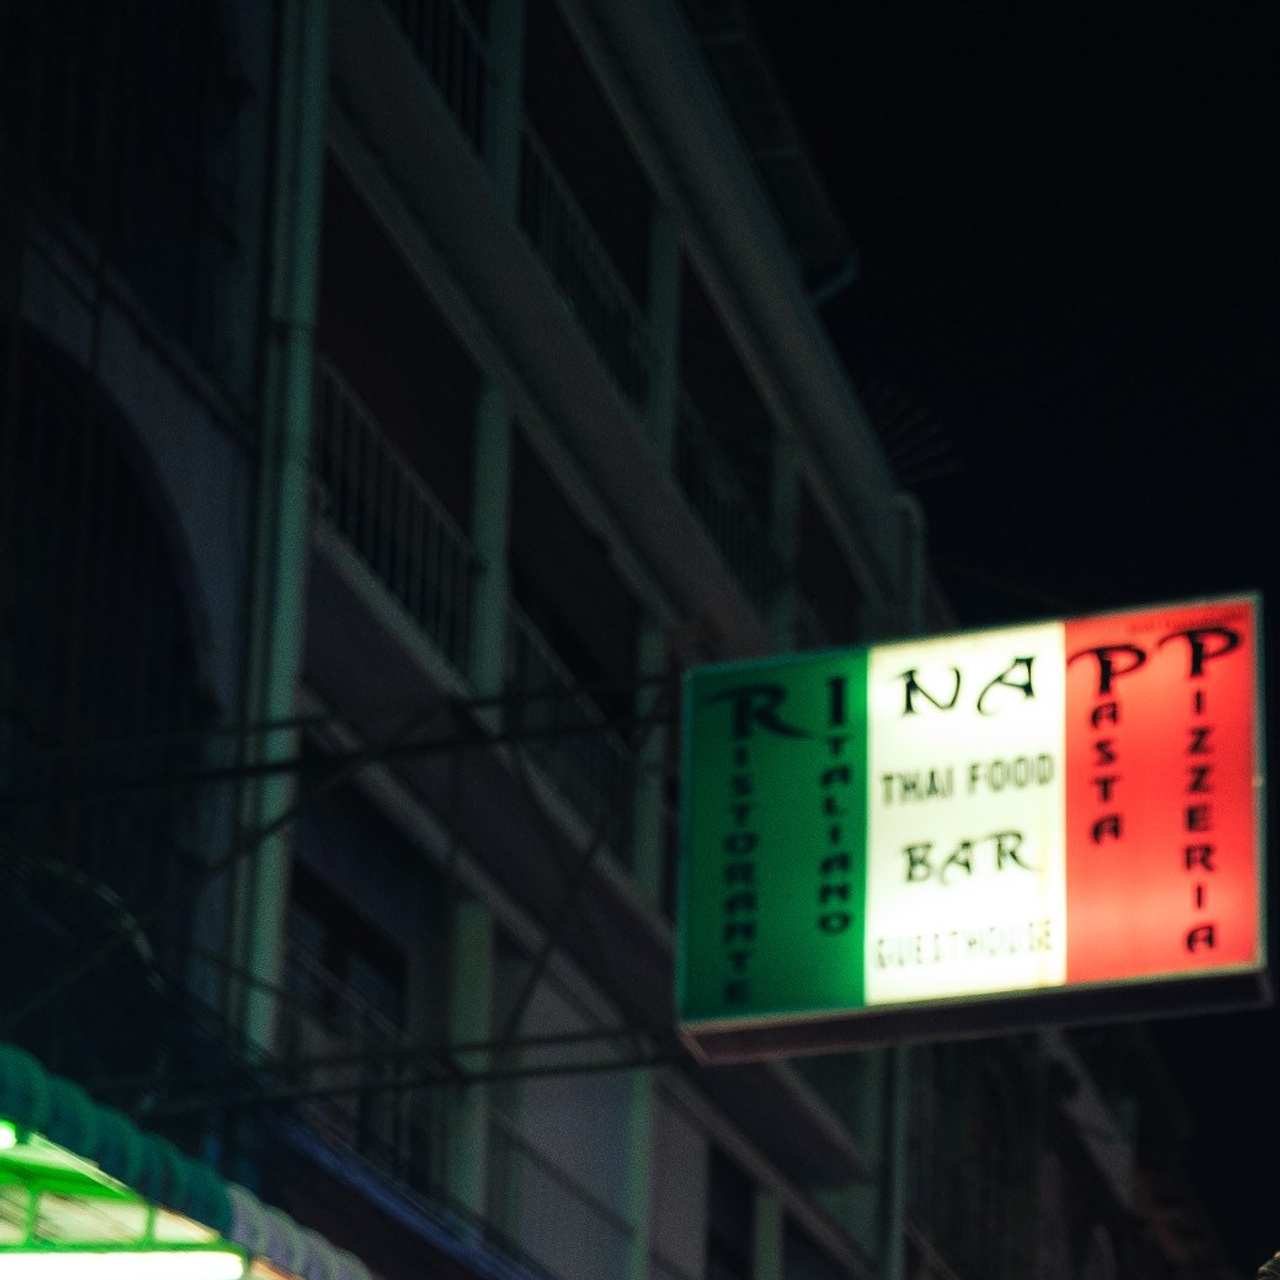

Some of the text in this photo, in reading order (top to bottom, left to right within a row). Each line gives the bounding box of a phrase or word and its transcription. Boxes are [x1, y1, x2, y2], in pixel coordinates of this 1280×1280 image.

[880, 753, 1055, 805] THAI FOOD
[1067, 643, 1147, 845] PASTA
[1155, 625, 1241, 953] PIZZERIA
[901, 829, 1040, 885] BAR
